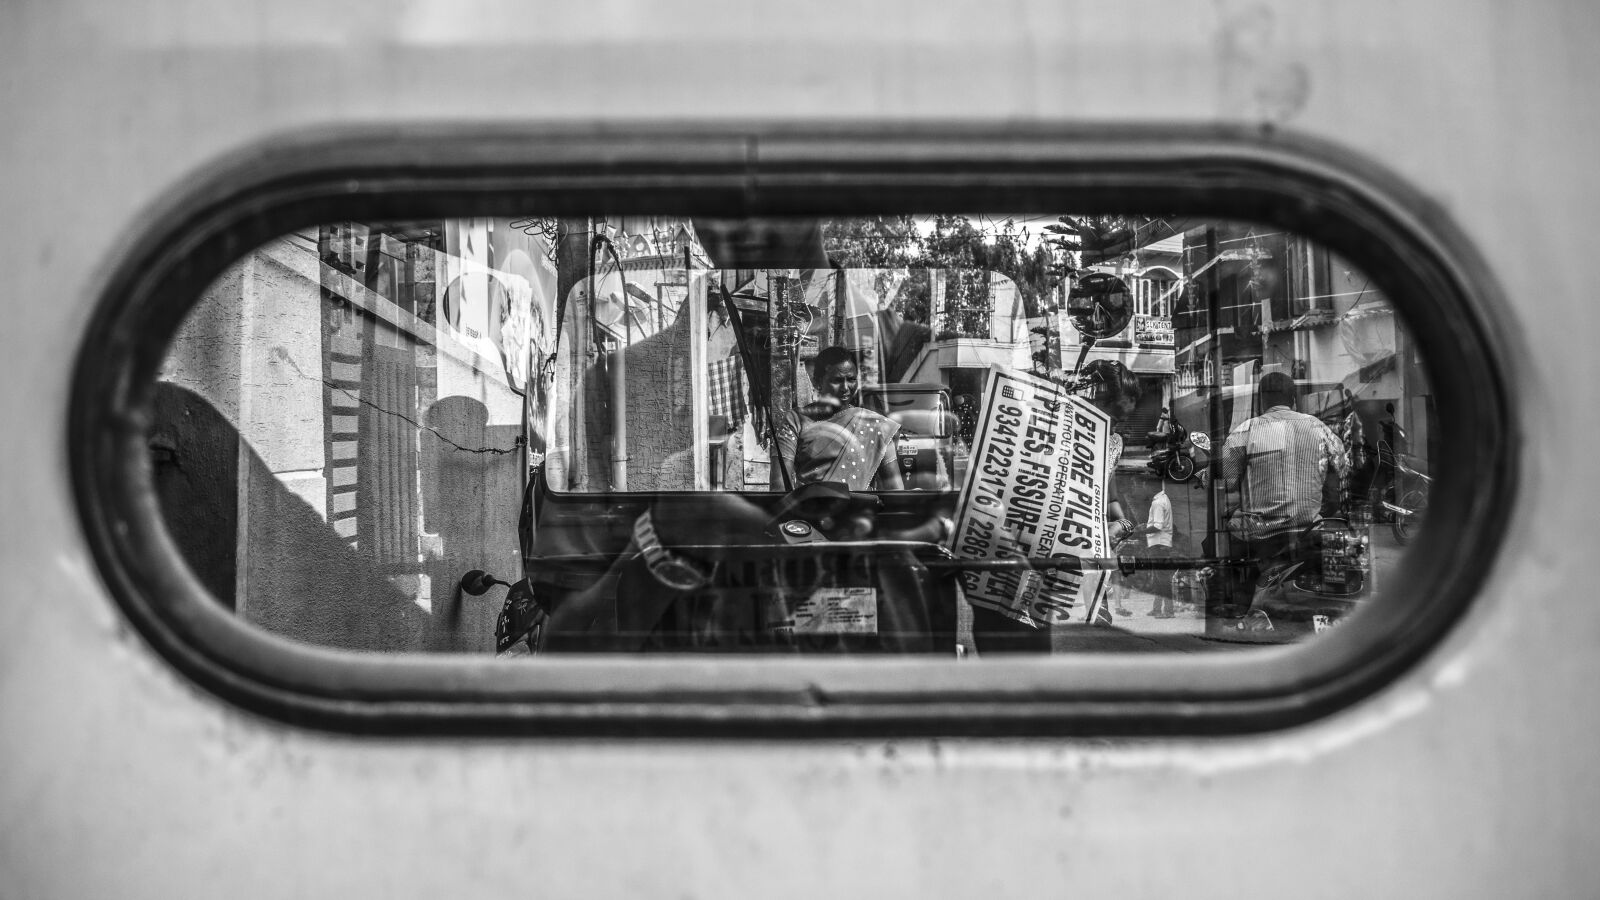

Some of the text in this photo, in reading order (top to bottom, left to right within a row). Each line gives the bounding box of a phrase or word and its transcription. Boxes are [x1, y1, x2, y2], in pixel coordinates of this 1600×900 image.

[975, 403, 1023, 507] 9341223176
[1060, 403, 1074, 455] WITHOUT
[1070, 412, 1097, 490] B'LORE
[1046, 456, 1069, 521] OPERATION
[1057, 487, 1093, 550] PILES
[960, 517, 995, 590] 22866
